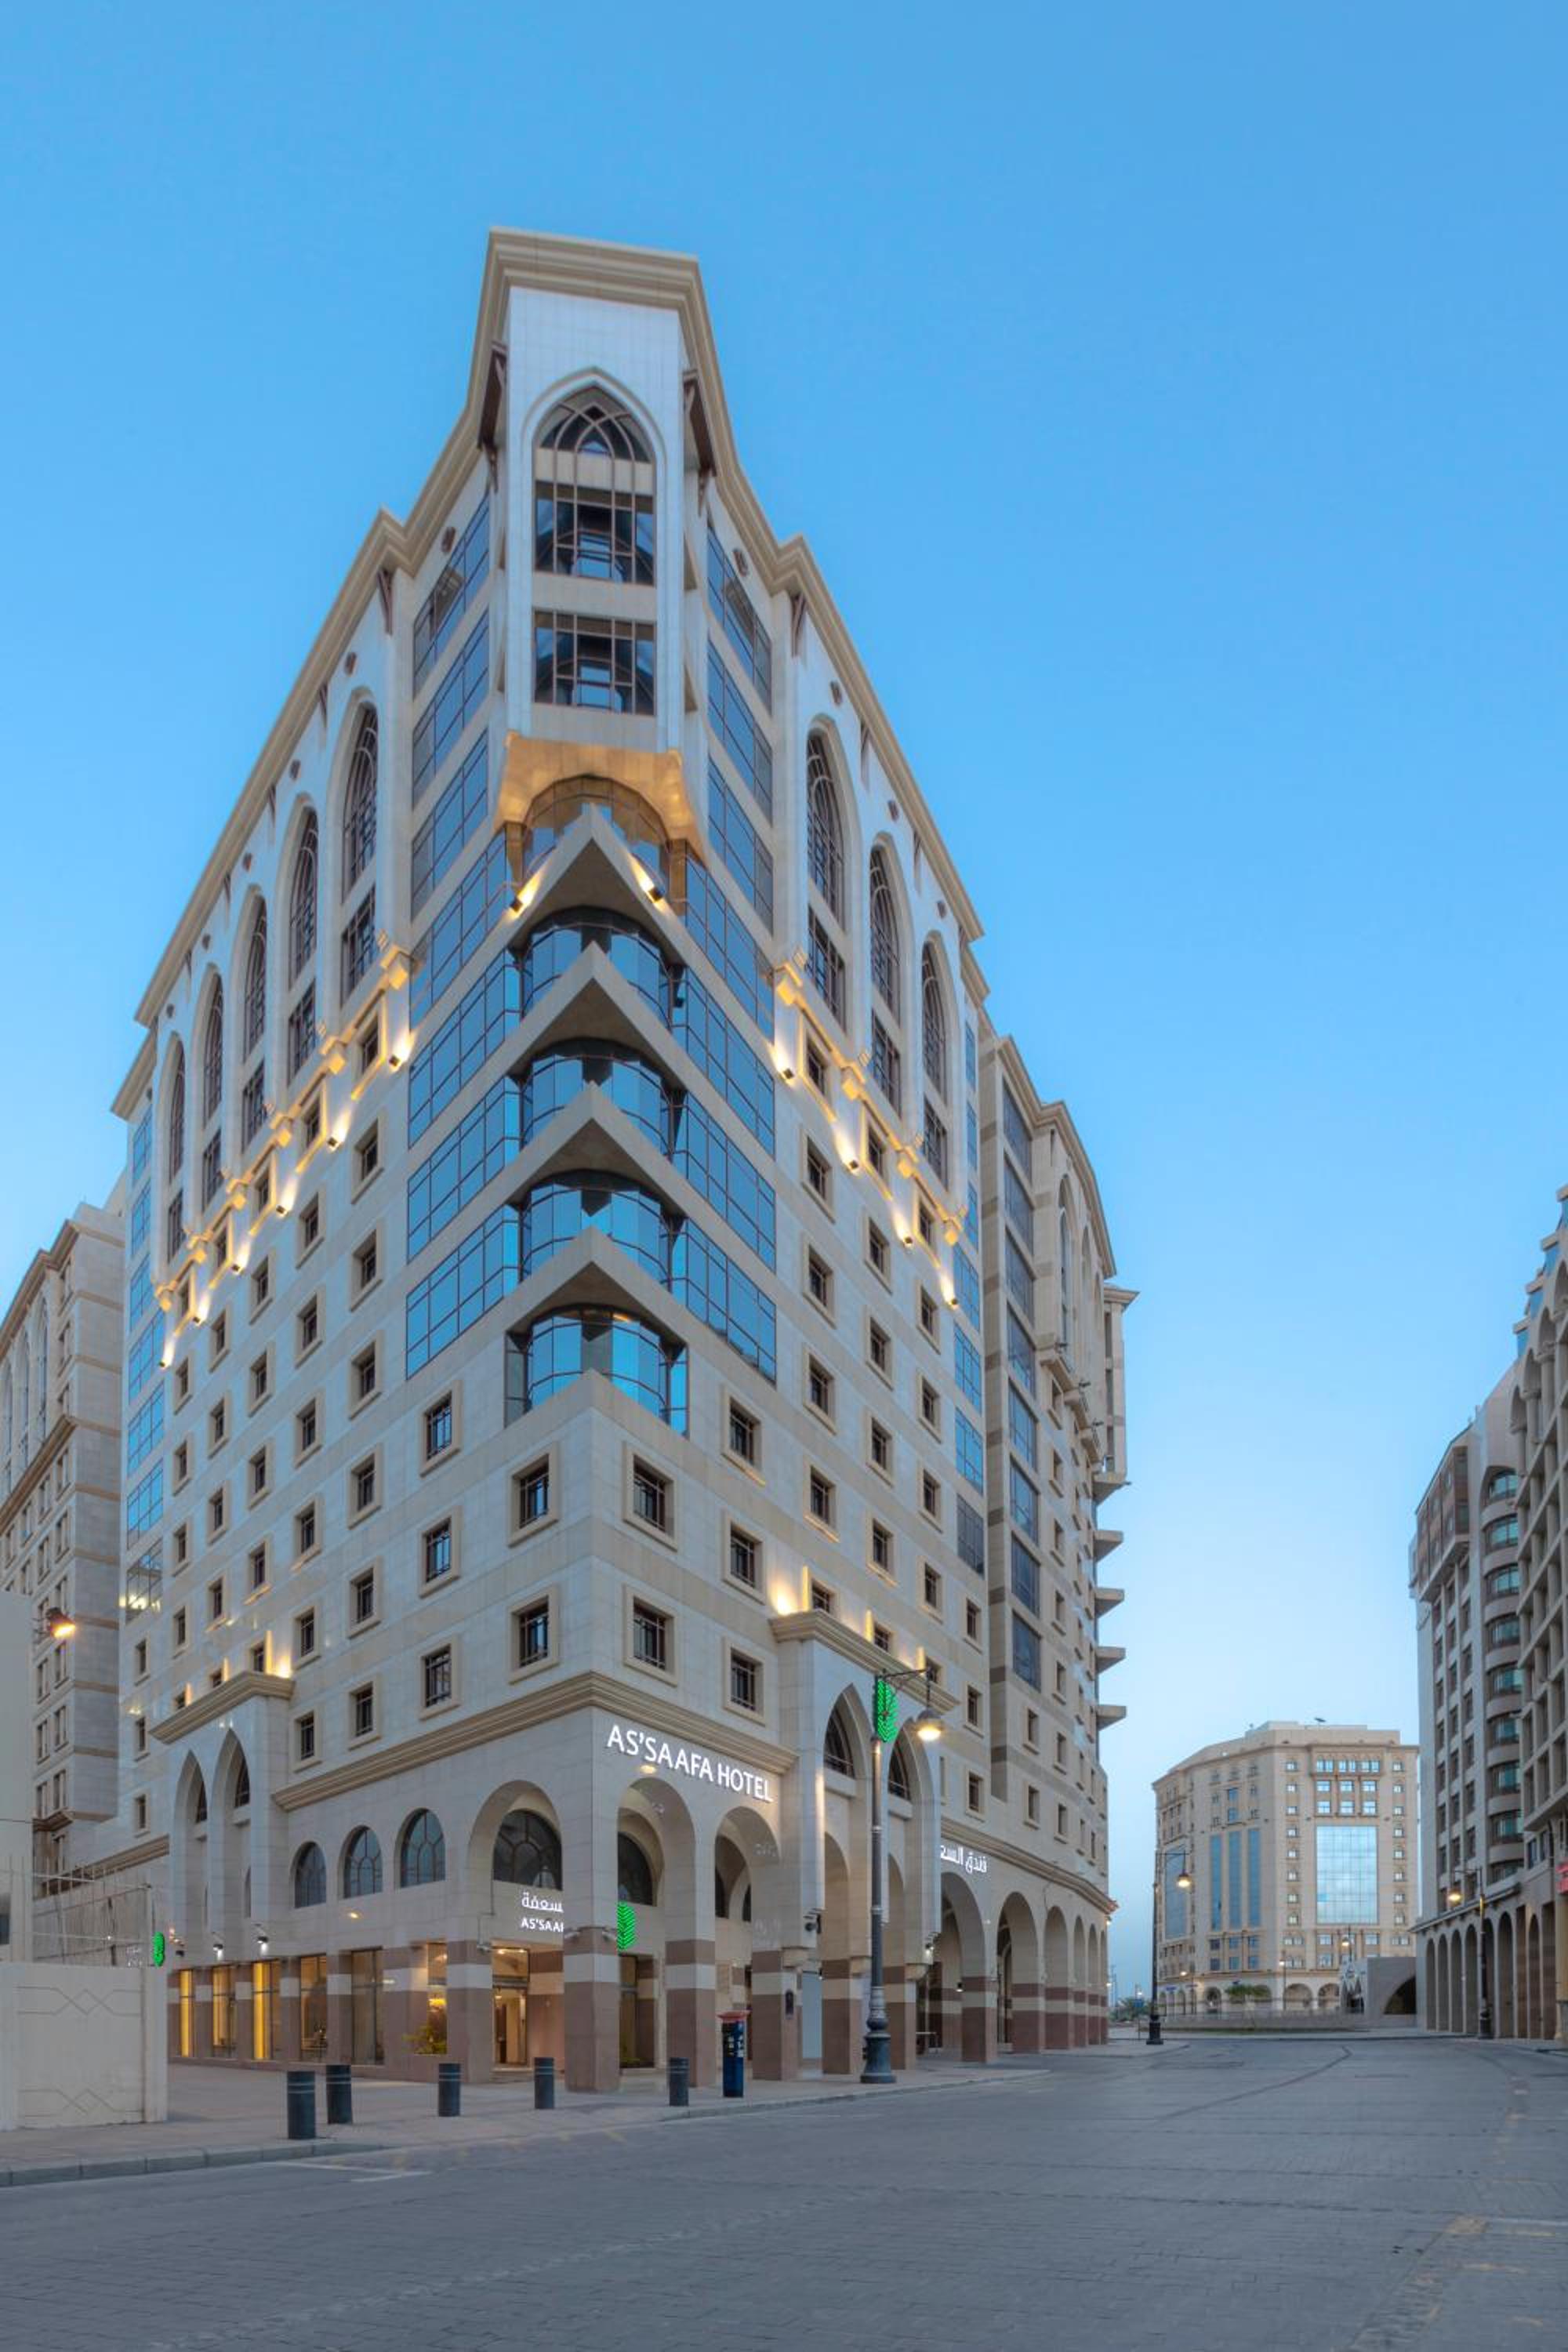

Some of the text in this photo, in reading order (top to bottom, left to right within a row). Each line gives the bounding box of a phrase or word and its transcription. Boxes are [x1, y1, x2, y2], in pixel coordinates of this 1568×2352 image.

[607, 1724, 774, 1803] AS'SAAFA HOTEL
[940, 1845, 987, 1874] فندق السع
[521, 1891, 564, 1913] سعفة
